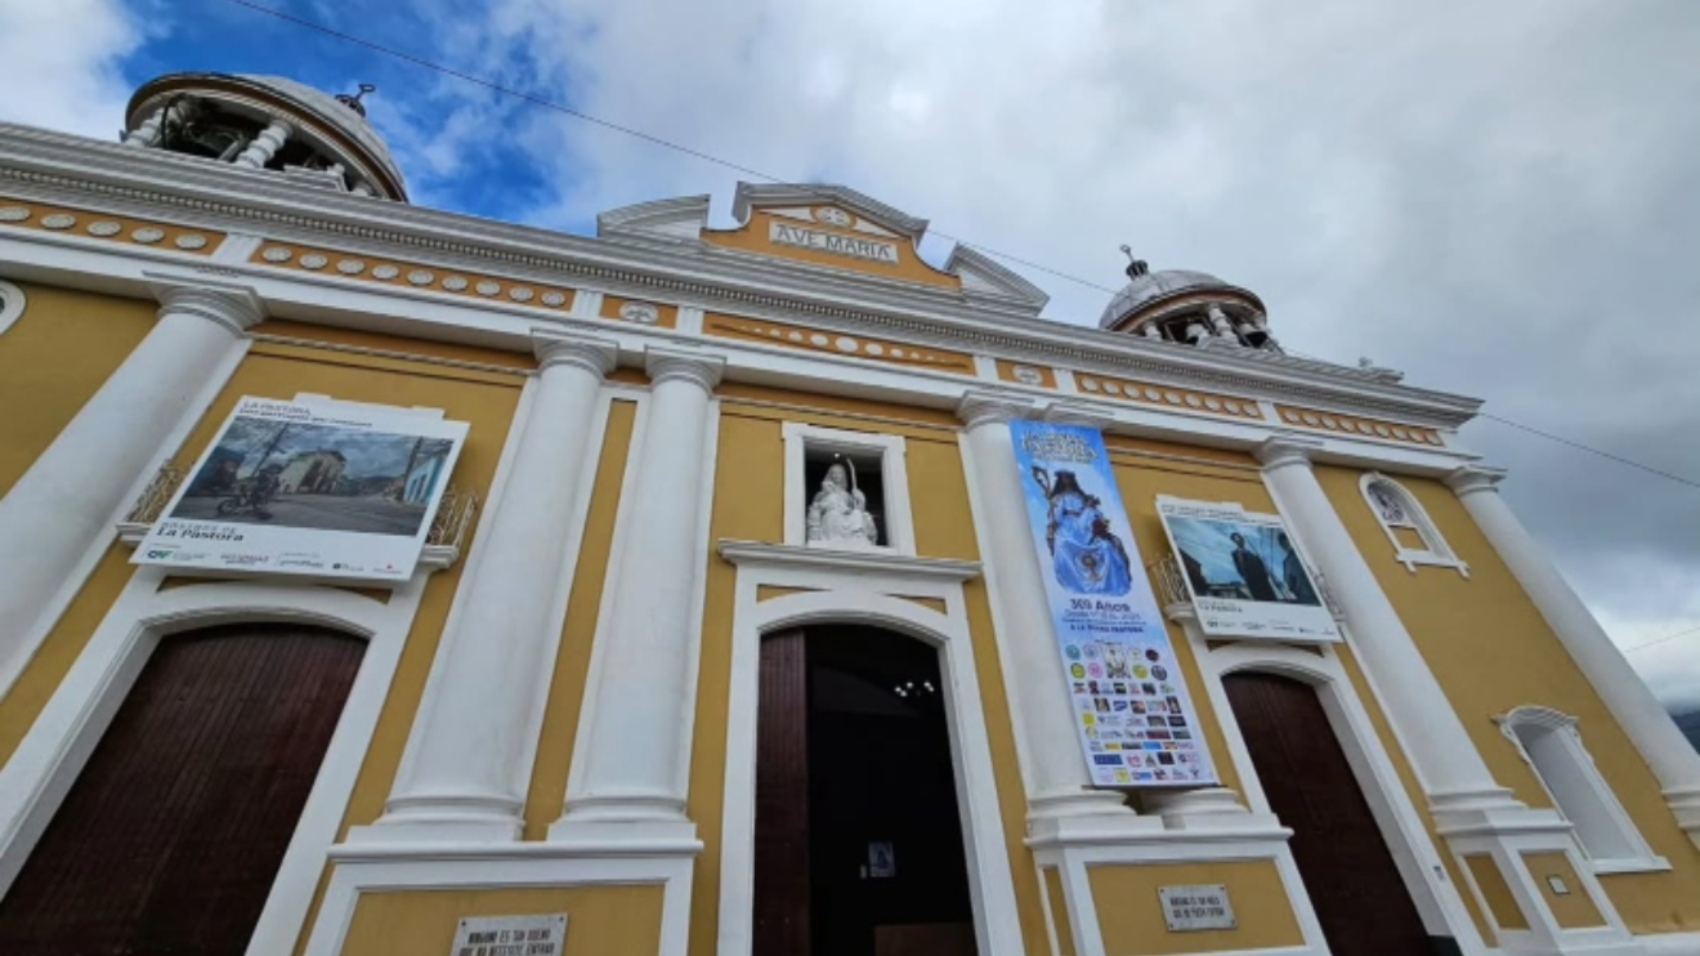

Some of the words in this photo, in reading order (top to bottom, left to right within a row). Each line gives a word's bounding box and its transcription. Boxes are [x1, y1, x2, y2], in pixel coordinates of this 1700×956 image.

[776, 223, 821, 247] AVE
[157, 525, 178, 537] La
[180, 528, 244, 541] Pastora
